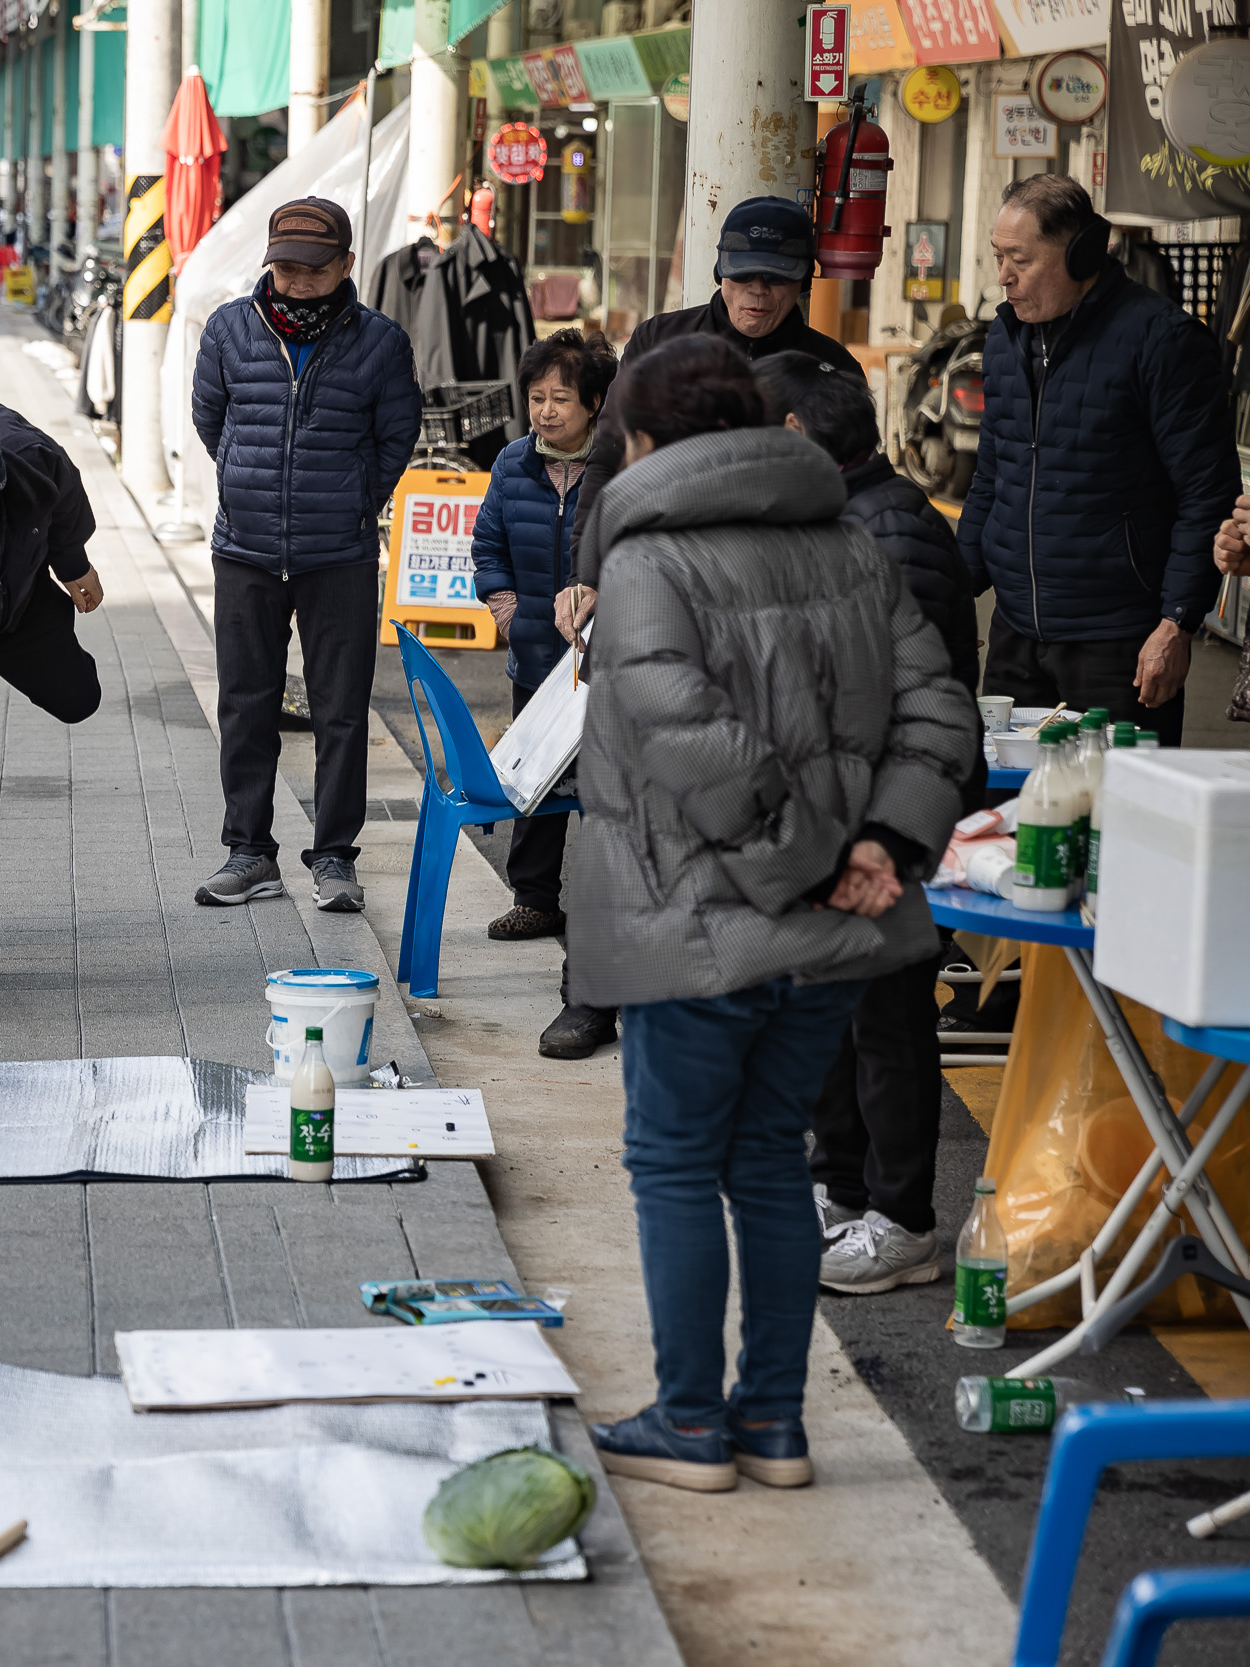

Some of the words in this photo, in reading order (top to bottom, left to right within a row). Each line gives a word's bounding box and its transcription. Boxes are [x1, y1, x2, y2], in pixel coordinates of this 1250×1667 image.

[812, 52, 843, 64] 소화기
[911, 88, 952, 111] 수선
[299, 1123, 332, 1143] 장수
